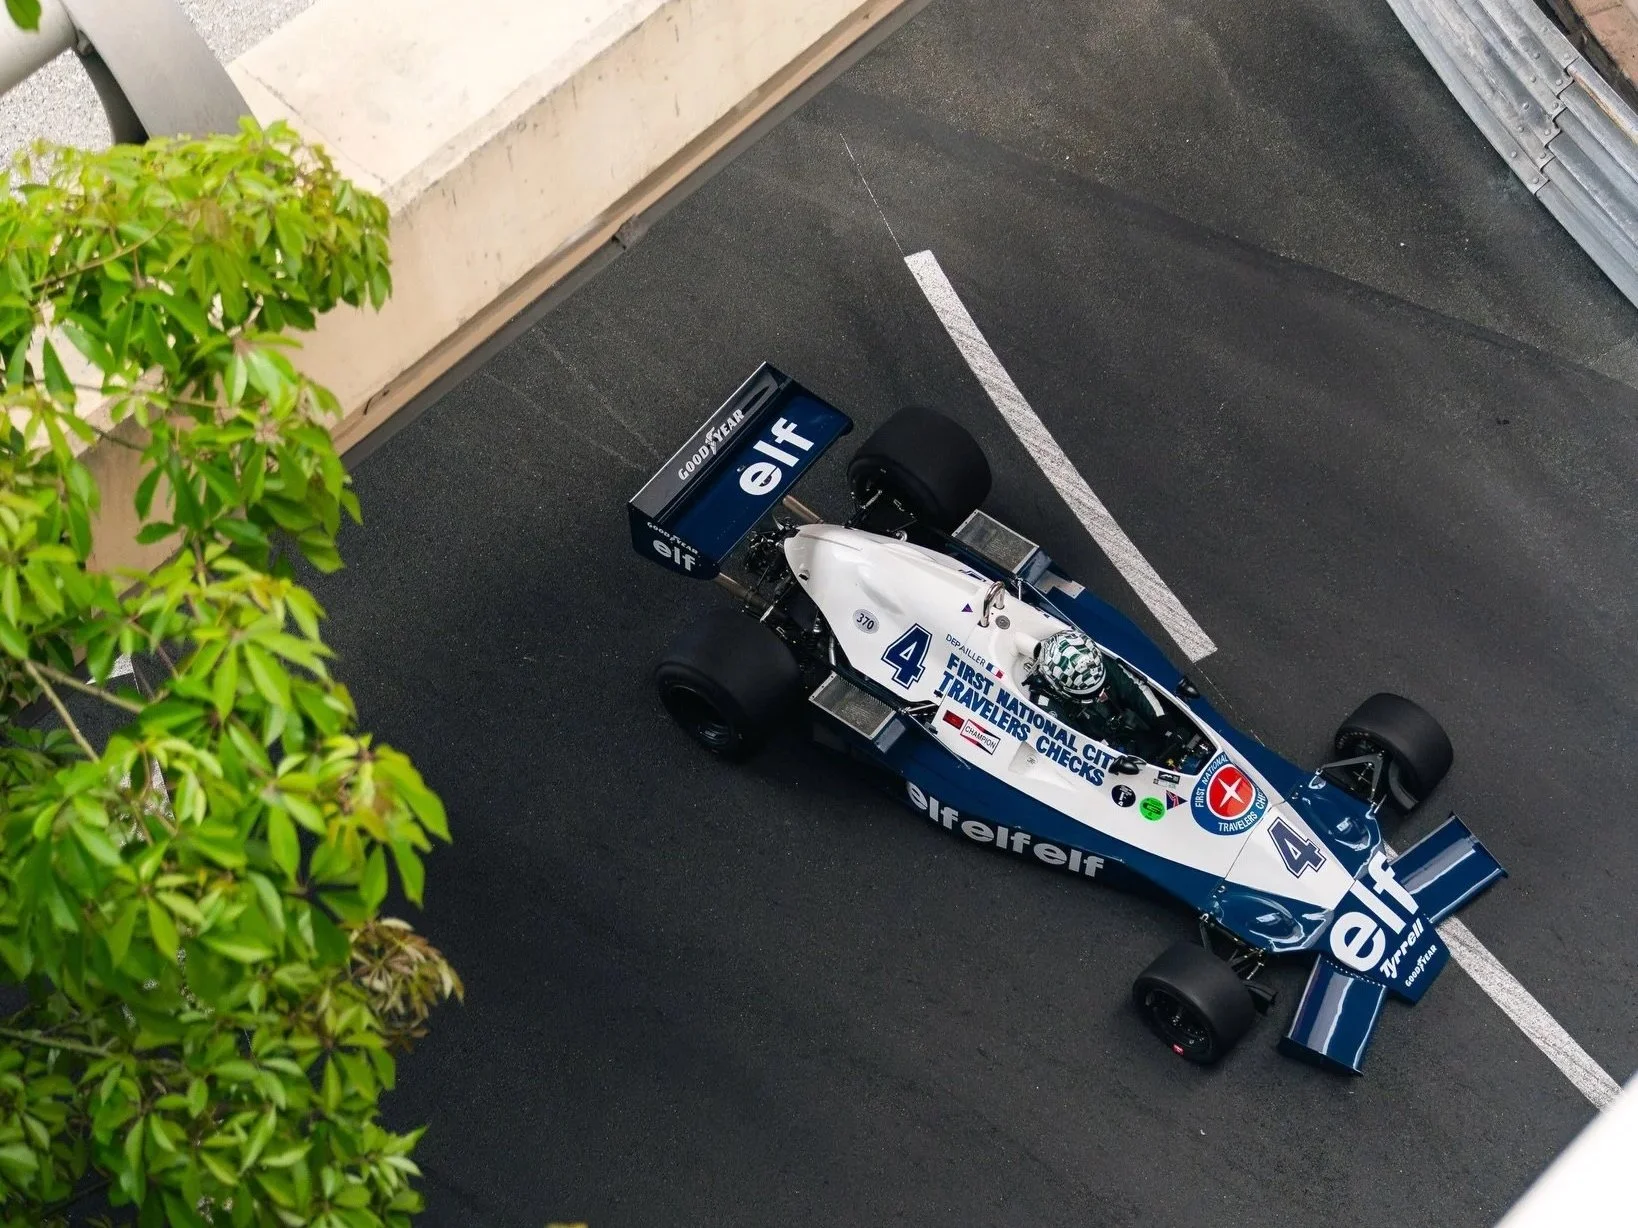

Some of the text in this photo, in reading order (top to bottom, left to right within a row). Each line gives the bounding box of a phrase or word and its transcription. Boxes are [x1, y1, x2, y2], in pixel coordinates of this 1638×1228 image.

[678, 409, 745, 480] GOODYEAR
[739, 417, 815, 496] elf
[653, 540, 696, 571] elf
[857, 612, 875, 630] 370
[945, 633, 986, 667] DEPAILLER
[881, 623, 933, 690] 4
[937, 670, 1105, 787] TRAVELERS CHECKS
[946, 652, 995, 694] FIRST
[1000, 687, 1078, 758] NATIONAL
[1082, 743, 1116, 770] CIT
[964, 725, 997, 749] CHAMPION
[1195, 754, 1229, 808] FIRST NATIONAL
[1218, 811, 1258, 832] TRAVELERS
[1267, 816, 1327, 879] 4
[1330, 851, 1419, 972] elf
[1380, 918, 1425, 979] Tyrrell
[1405, 945, 1437, 987] GOODYEAR
